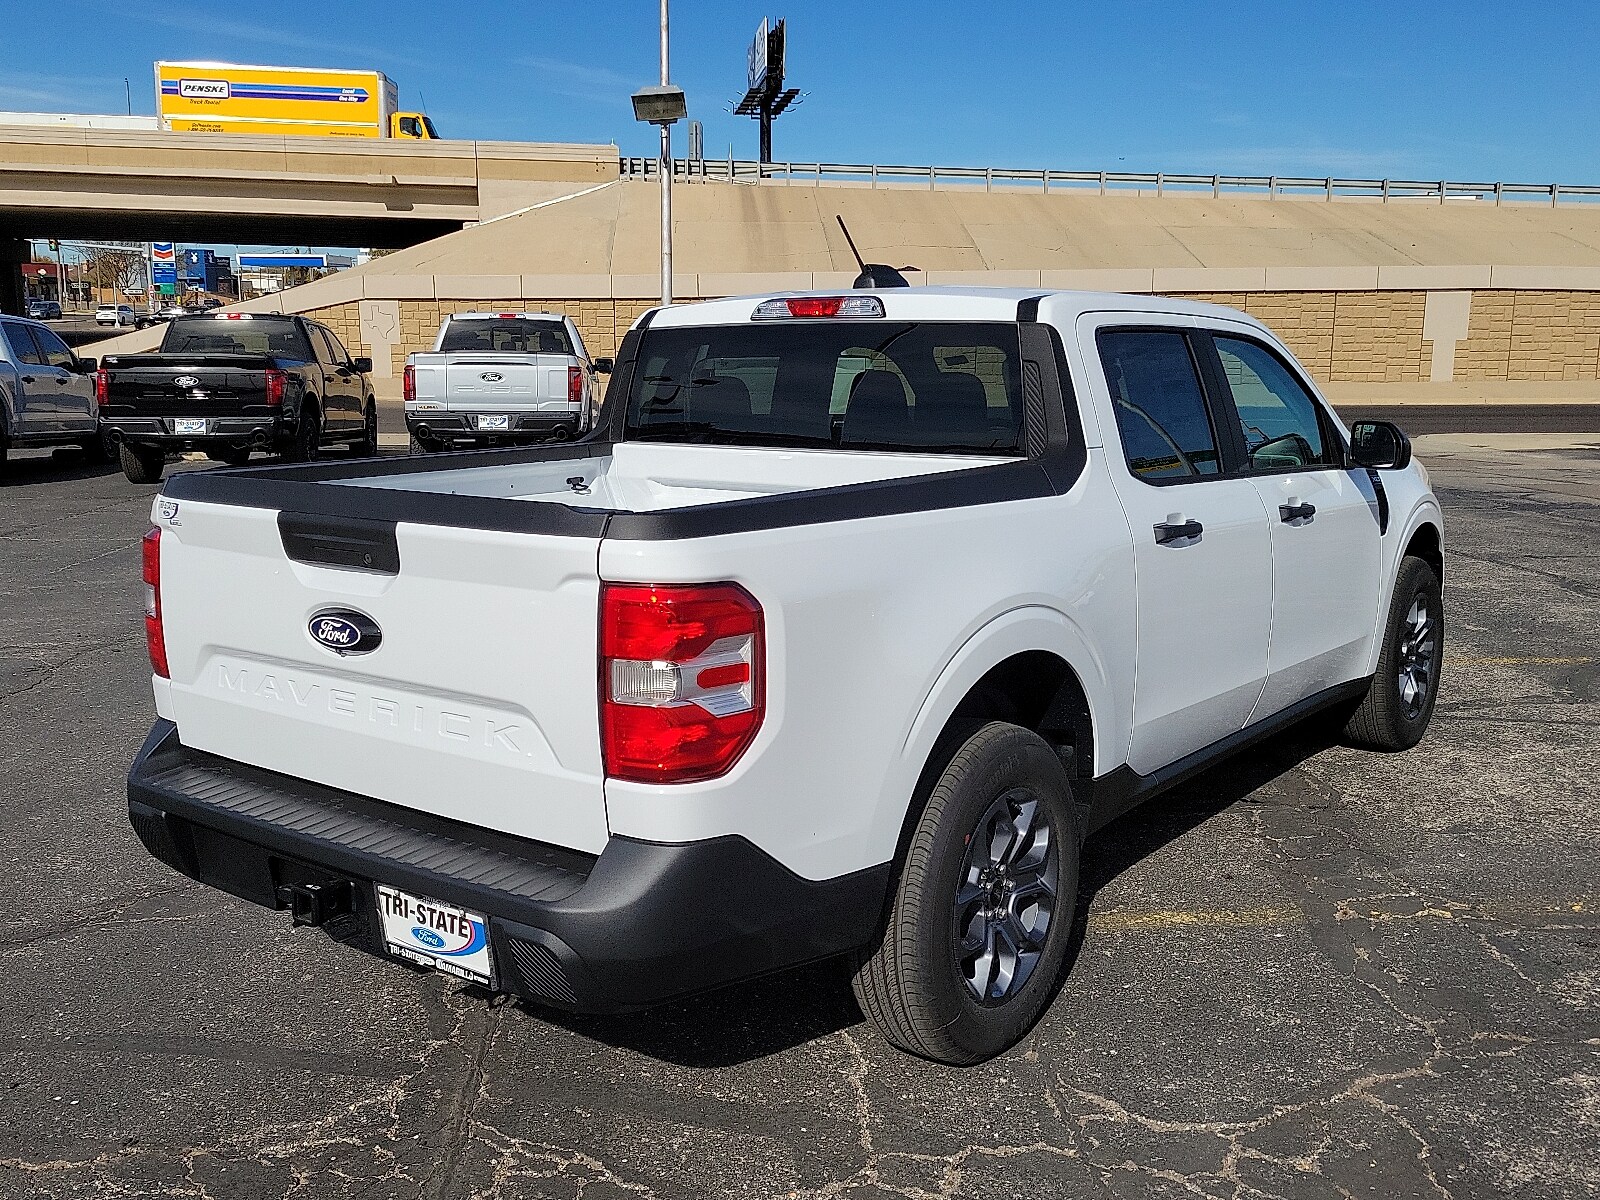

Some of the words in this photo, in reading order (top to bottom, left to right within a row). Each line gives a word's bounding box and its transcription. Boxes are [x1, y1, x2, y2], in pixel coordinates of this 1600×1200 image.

[183, 84, 226, 93] PENSKE
[318, 619, 350, 643] Ford
[217, 664, 521, 754] MAVERICK
[379, 891, 469, 939] TRI-STATE
[417, 929, 439, 946] Ford
